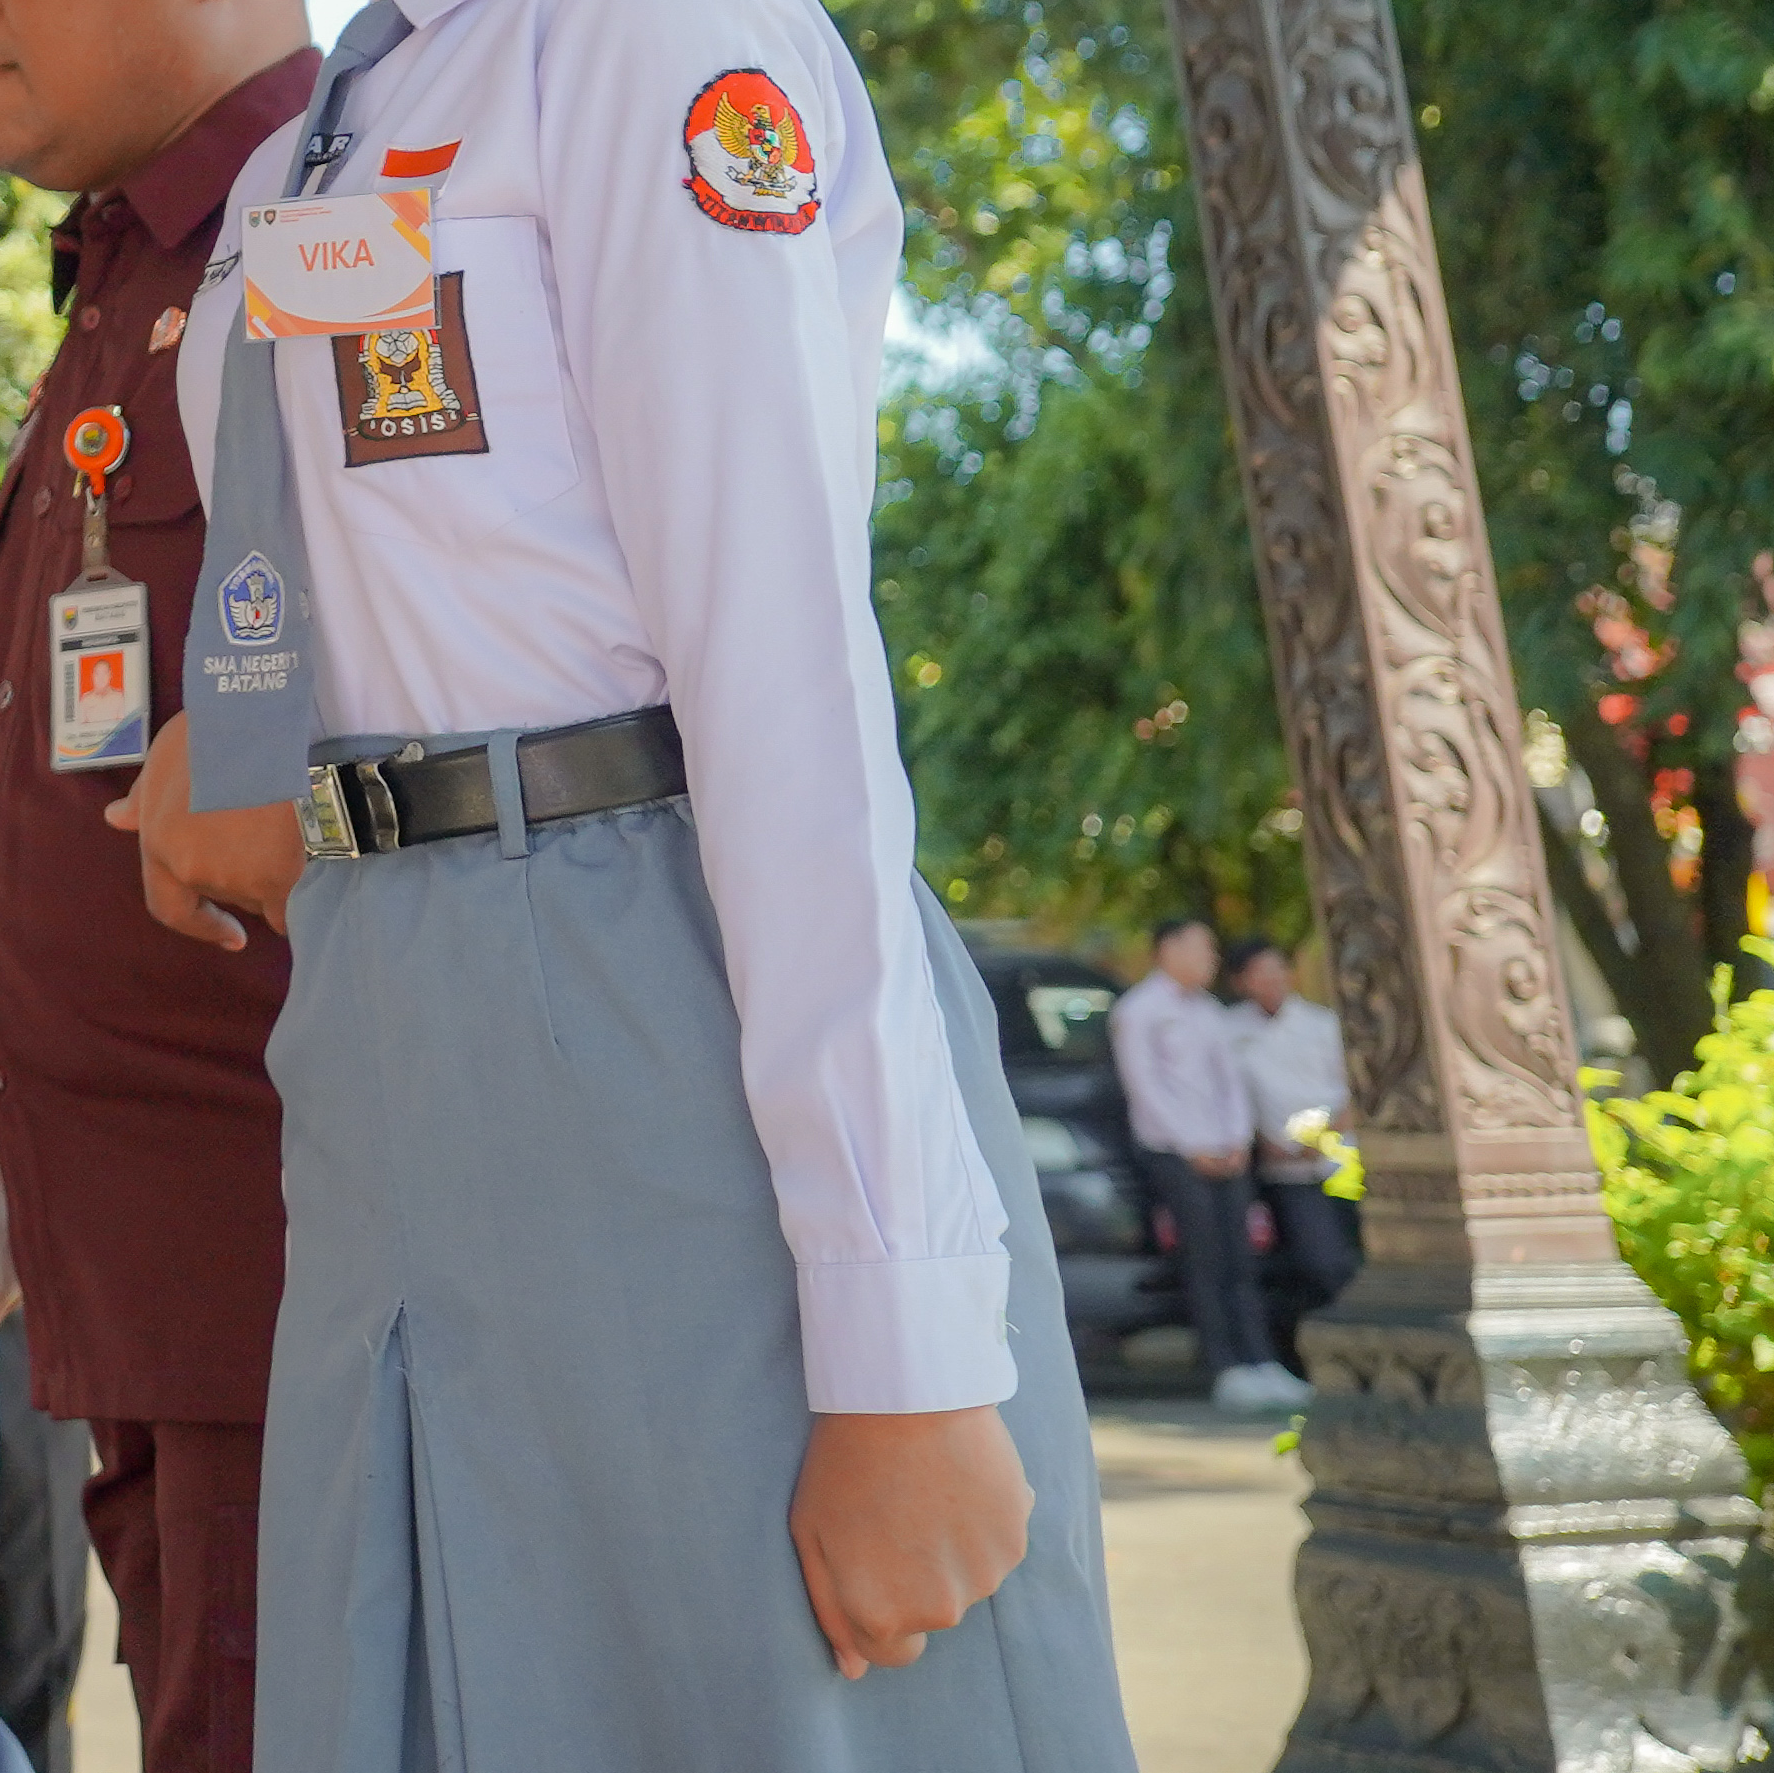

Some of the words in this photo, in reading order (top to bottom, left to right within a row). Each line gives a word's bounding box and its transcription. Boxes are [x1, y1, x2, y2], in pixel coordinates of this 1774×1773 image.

[298, 238, 375, 272] VIKA
[380, 412, 446, 437] OSIS
[204, 655, 237, 675] SMA
[217, 671, 288, 693] BATANG
